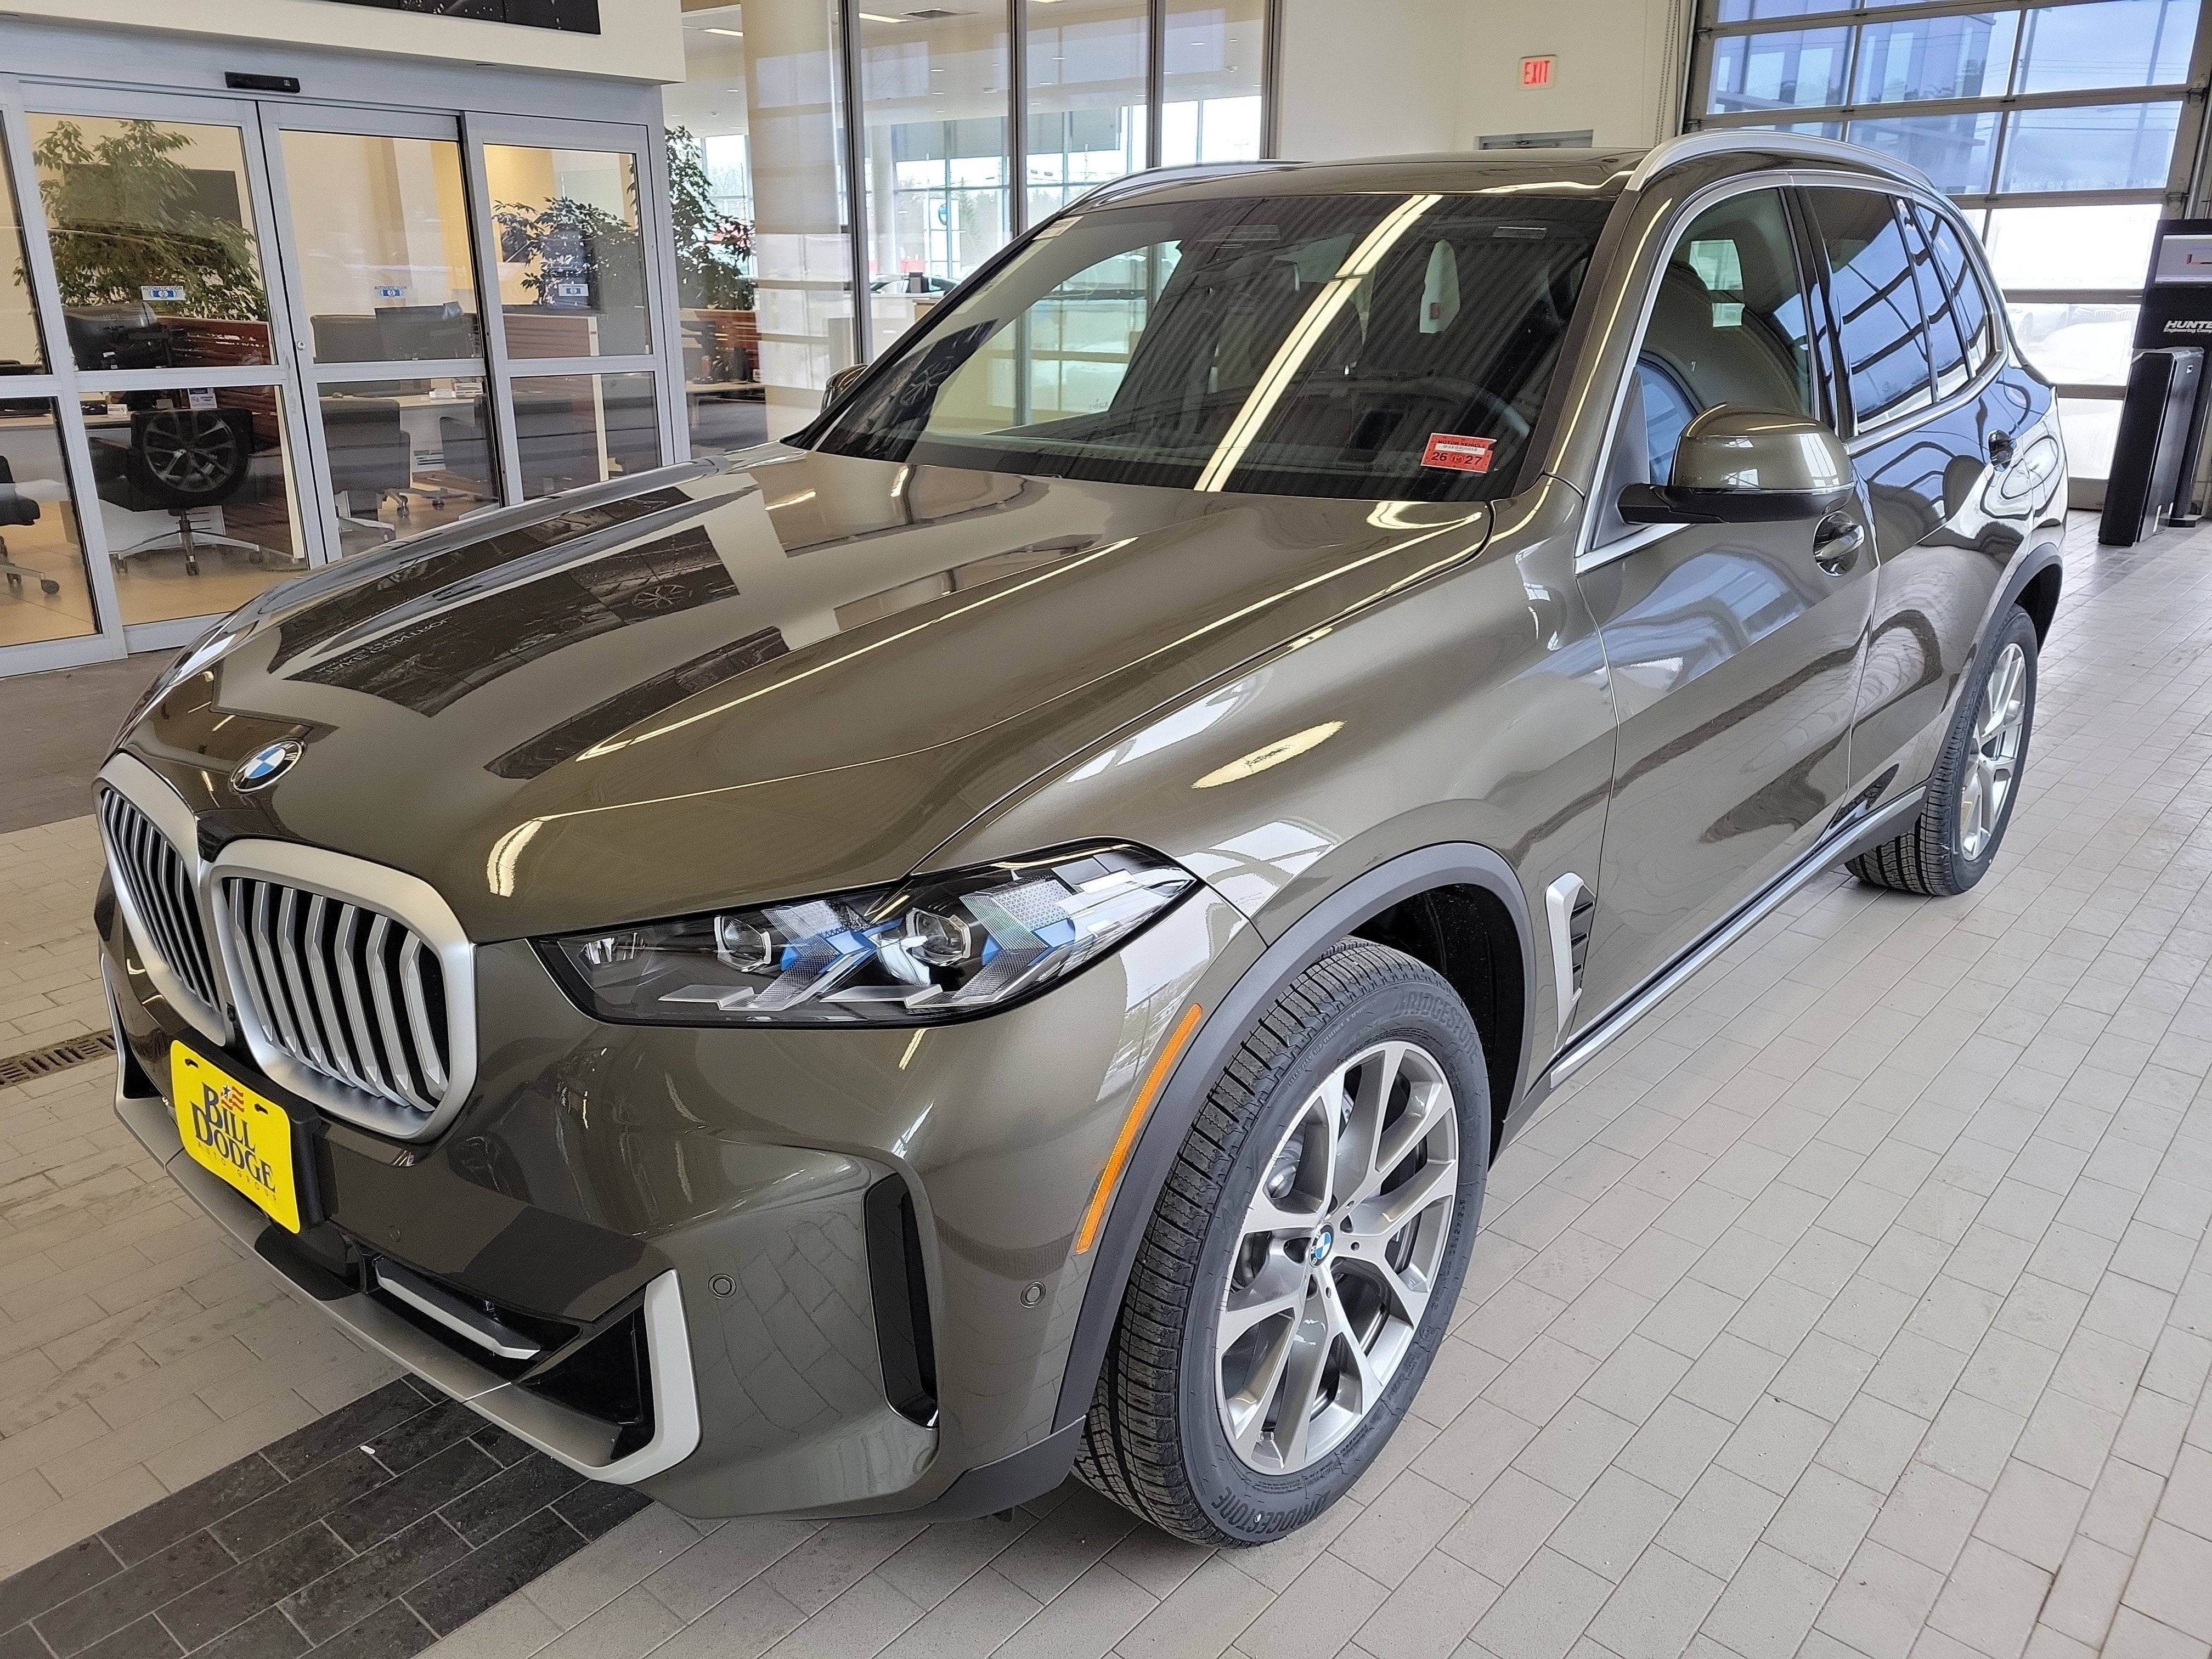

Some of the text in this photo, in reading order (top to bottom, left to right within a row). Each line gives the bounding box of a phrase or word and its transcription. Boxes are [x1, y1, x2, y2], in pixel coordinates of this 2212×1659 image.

[1524, 60, 1550, 84] EXIT
[1431, 452, 1483, 465] 26 27
[201, 1081, 256, 1154] BILL
[190, 1101, 276, 1193] DODGE
[198, 1141, 277, 1203] AUTO GROUP
[1210, 1486, 1331, 1535] BRIDGESTONE
